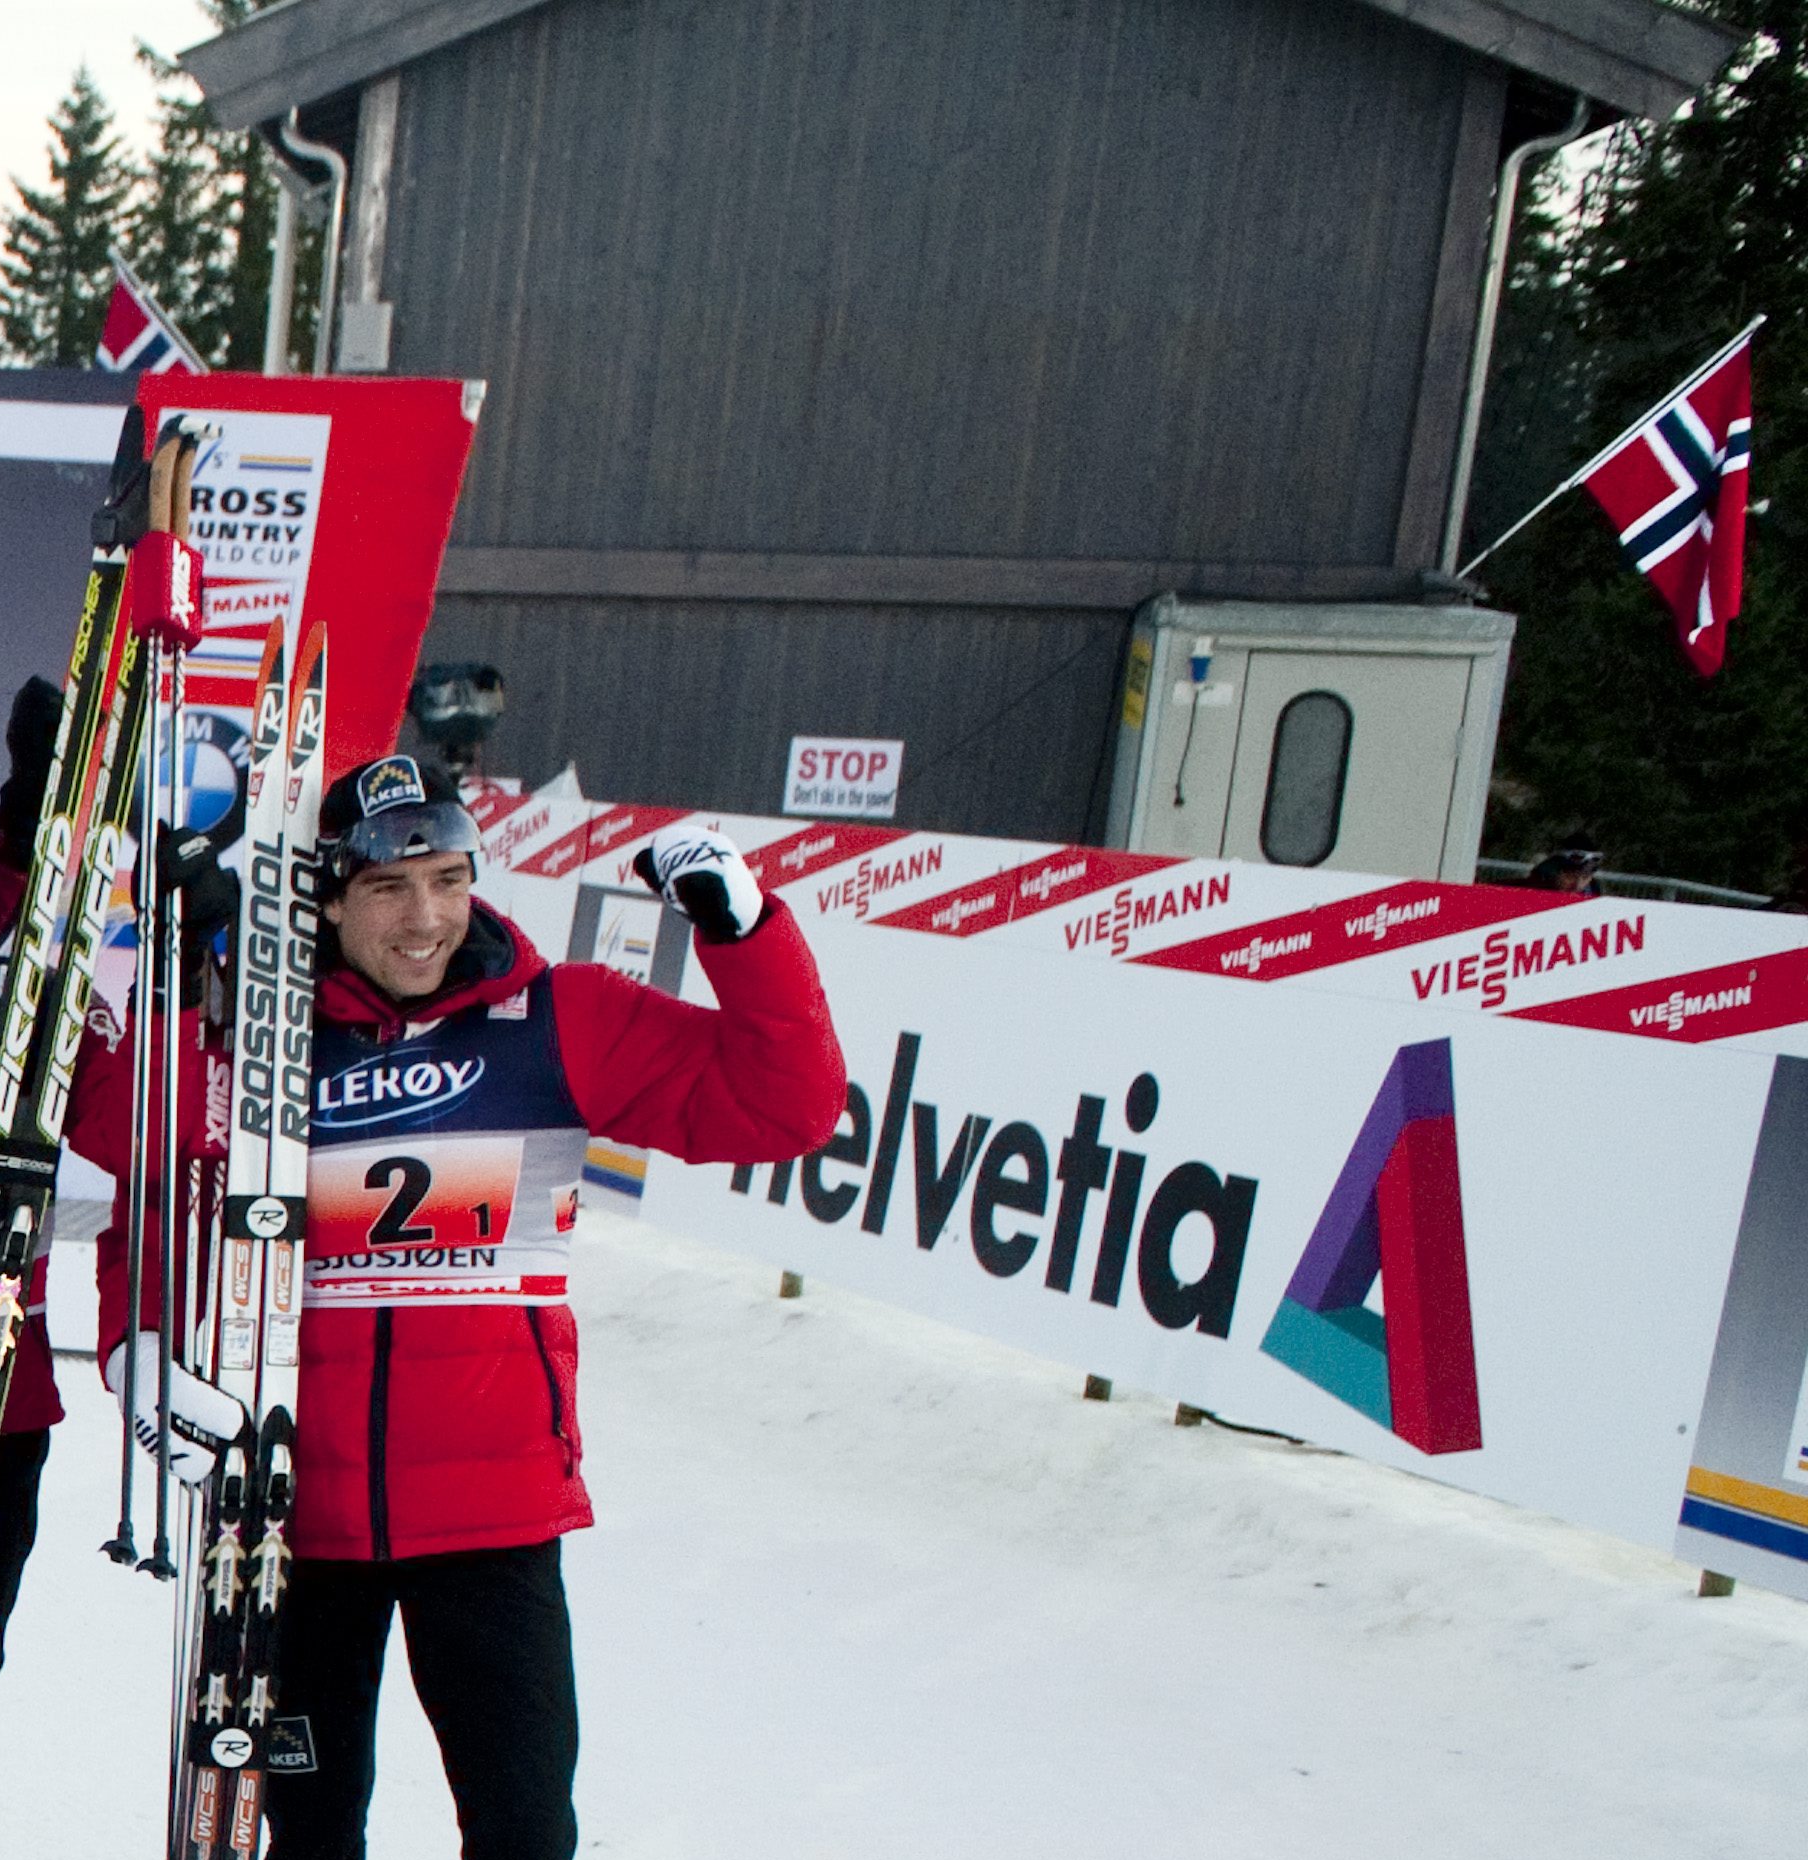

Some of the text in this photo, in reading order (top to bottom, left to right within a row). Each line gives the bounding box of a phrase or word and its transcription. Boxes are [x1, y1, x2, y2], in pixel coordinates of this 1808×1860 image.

[190, 488, 308, 518] ROSS
[190, 523, 303, 543] UNTRY
[250, 546, 302, 565] CUP
[797, 748, 888, 782] STOP
[364, 784, 421, 808] AKER
[239, 831, 285, 1140] ROSSIGNOL
[280, 838, 321, 1146] ROSSIGNOL
[316, 1059, 475, 1113] LERØY
[364, 1155, 492, 1247] 2 1
[730, 1031, 1259, 1340] elvetia
